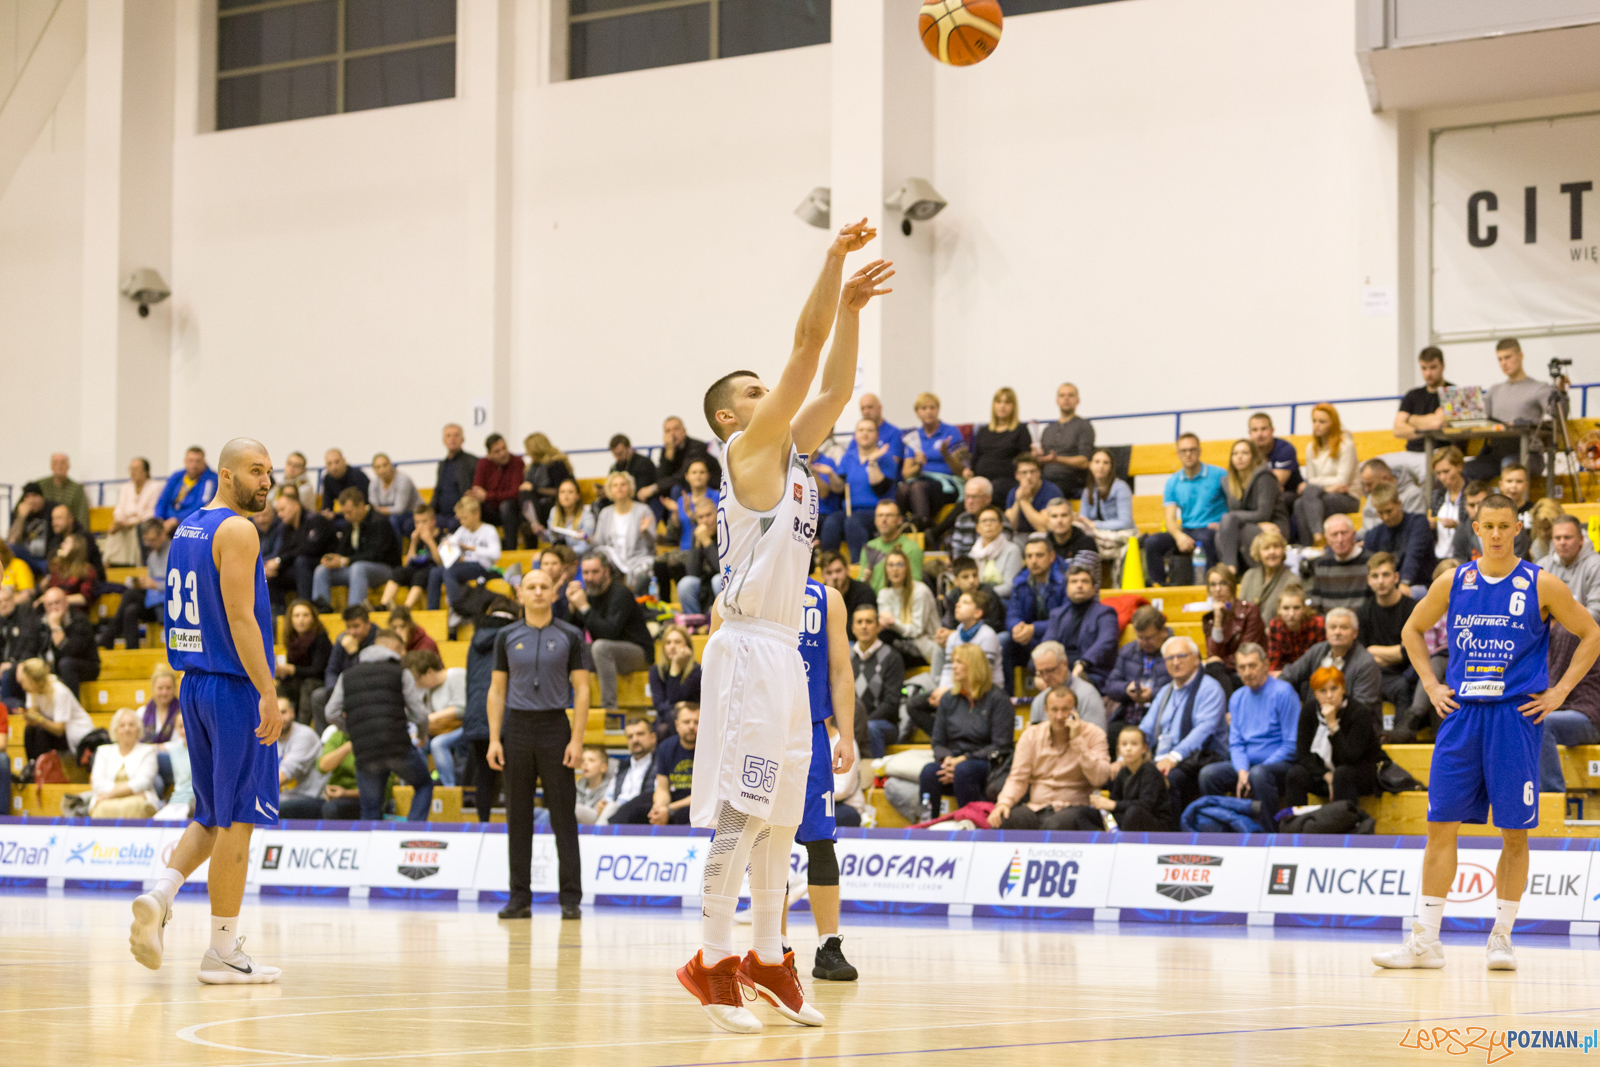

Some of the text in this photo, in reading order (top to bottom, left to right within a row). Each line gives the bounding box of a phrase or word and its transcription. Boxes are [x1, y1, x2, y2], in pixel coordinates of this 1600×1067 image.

[1467, 181, 1593, 248] CIT
[474, 406, 486, 426] D
[167, 568, 200, 625] 33
[1508, 591, 1526, 616] 6
[1453, 614, 1510, 628] Polfarmex
[1468, 651, 1496, 659] miasto
[1469, 638, 1515, 651] KUTNO
[742, 754, 779, 793] 55
[741, 791, 770, 804] macron
[1523, 781, 1535, 806] 6
[0, 841, 49, 865] Znan
[91, 842, 154, 859] funclub
[287, 848, 360, 870] NICKEL
[402, 850, 439, 865] JOKER
[1027, 847, 1083, 859] fundacja
[595, 855, 688, 882] POZnan
[840, 854, 957, 879] BIOFARM
[1163, 867, 1210, 883] JOKER
[1021, 860, 1079, 898] PBG
[1306, 868, 1411, 895] NICKEL
[1449, 872, 1483, 893] IA
